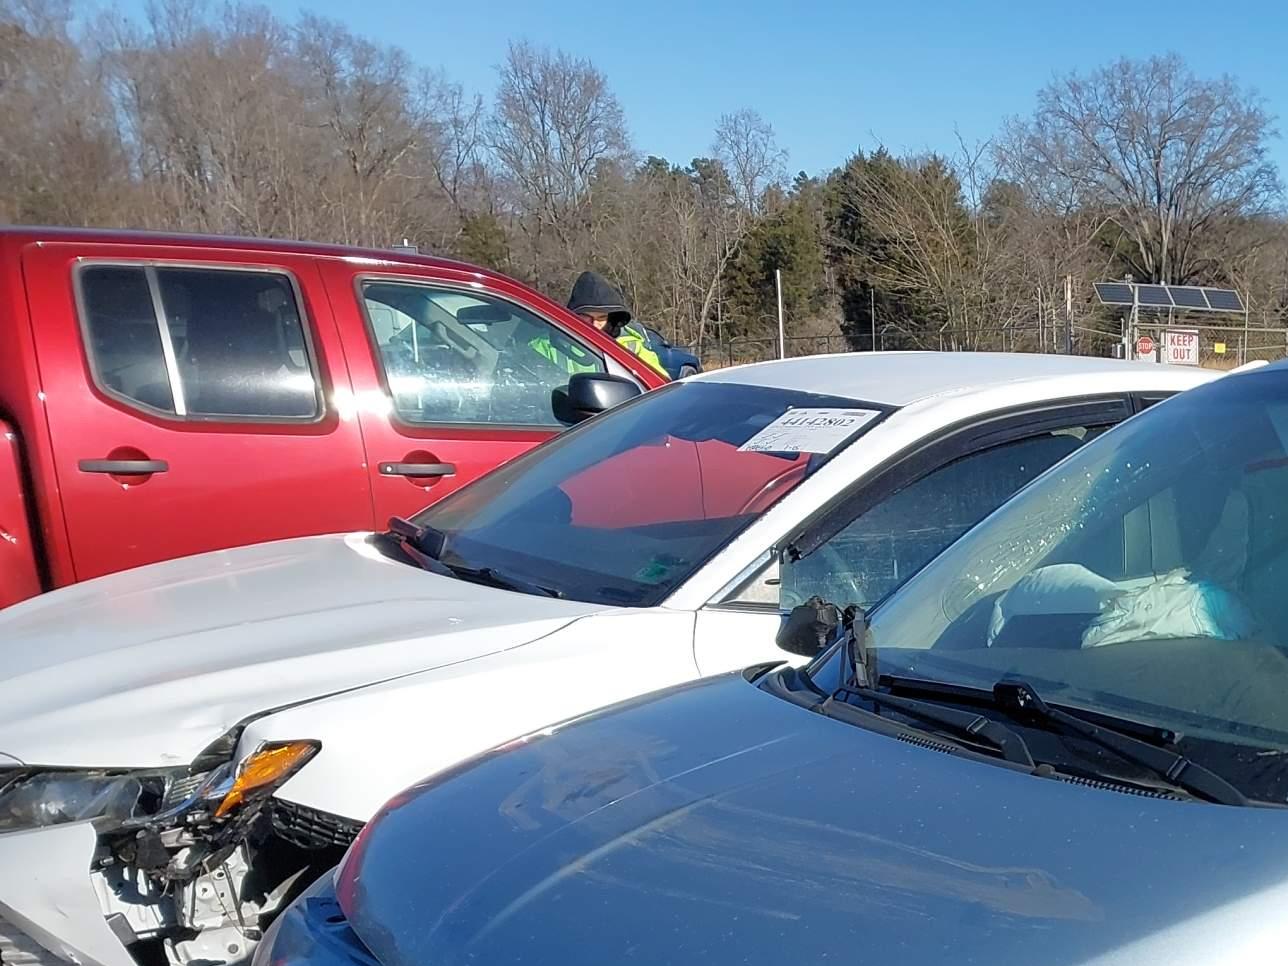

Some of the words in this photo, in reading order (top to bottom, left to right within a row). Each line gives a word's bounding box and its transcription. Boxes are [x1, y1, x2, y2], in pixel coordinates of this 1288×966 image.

[1170, 335, 1194, 346] KEEP
[1138, 342, 1153, 350] STOP
[1173, 348, 1191, 360] OUT
[781, 417, 855, 427] 44142802
